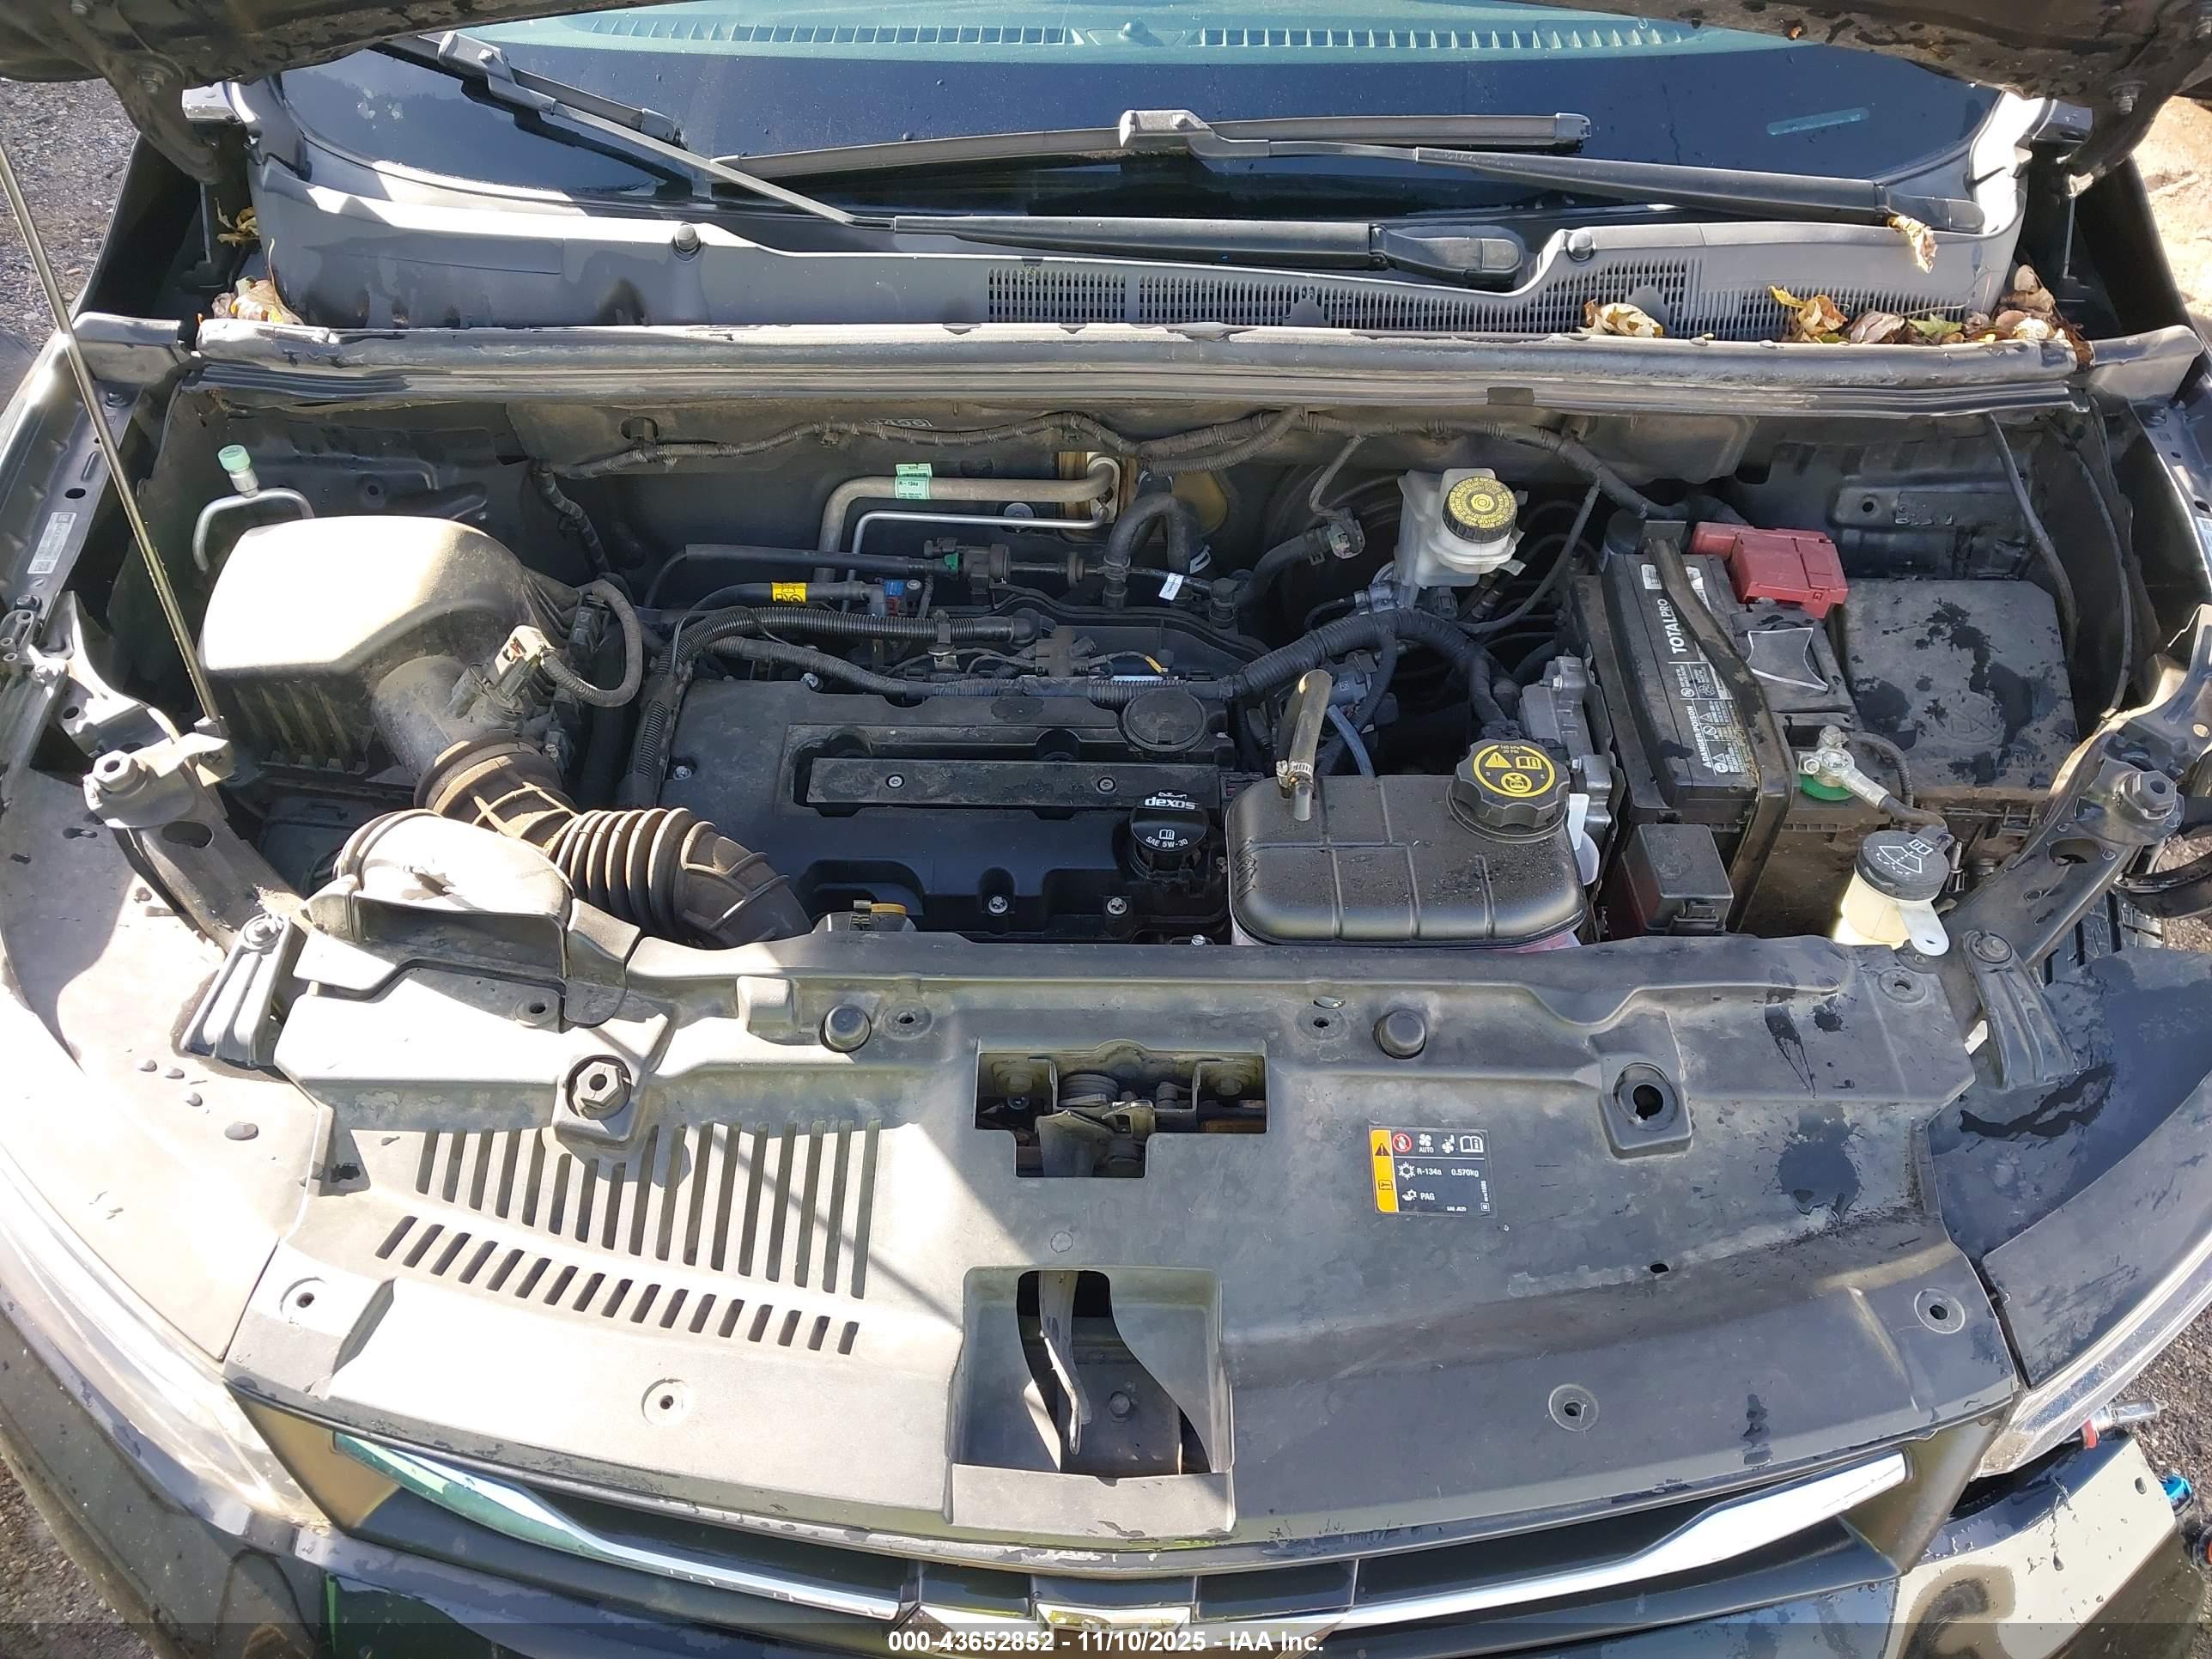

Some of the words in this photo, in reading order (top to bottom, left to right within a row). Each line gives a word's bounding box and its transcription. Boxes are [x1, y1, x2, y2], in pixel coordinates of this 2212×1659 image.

[1686, 705, 1712, 763] DANGER/POISON
[1145, 797, 1199, 810] dexos
[1146, 836, 1160, 847] SAE
[1162, 838, 1188, 848] 5W-30
[1417, 1167, 1443, 1176] R-134a
[1450, 1168, 1480, 1177] 0.570kg
[1419, 1192, 1435, 1200] PAG
